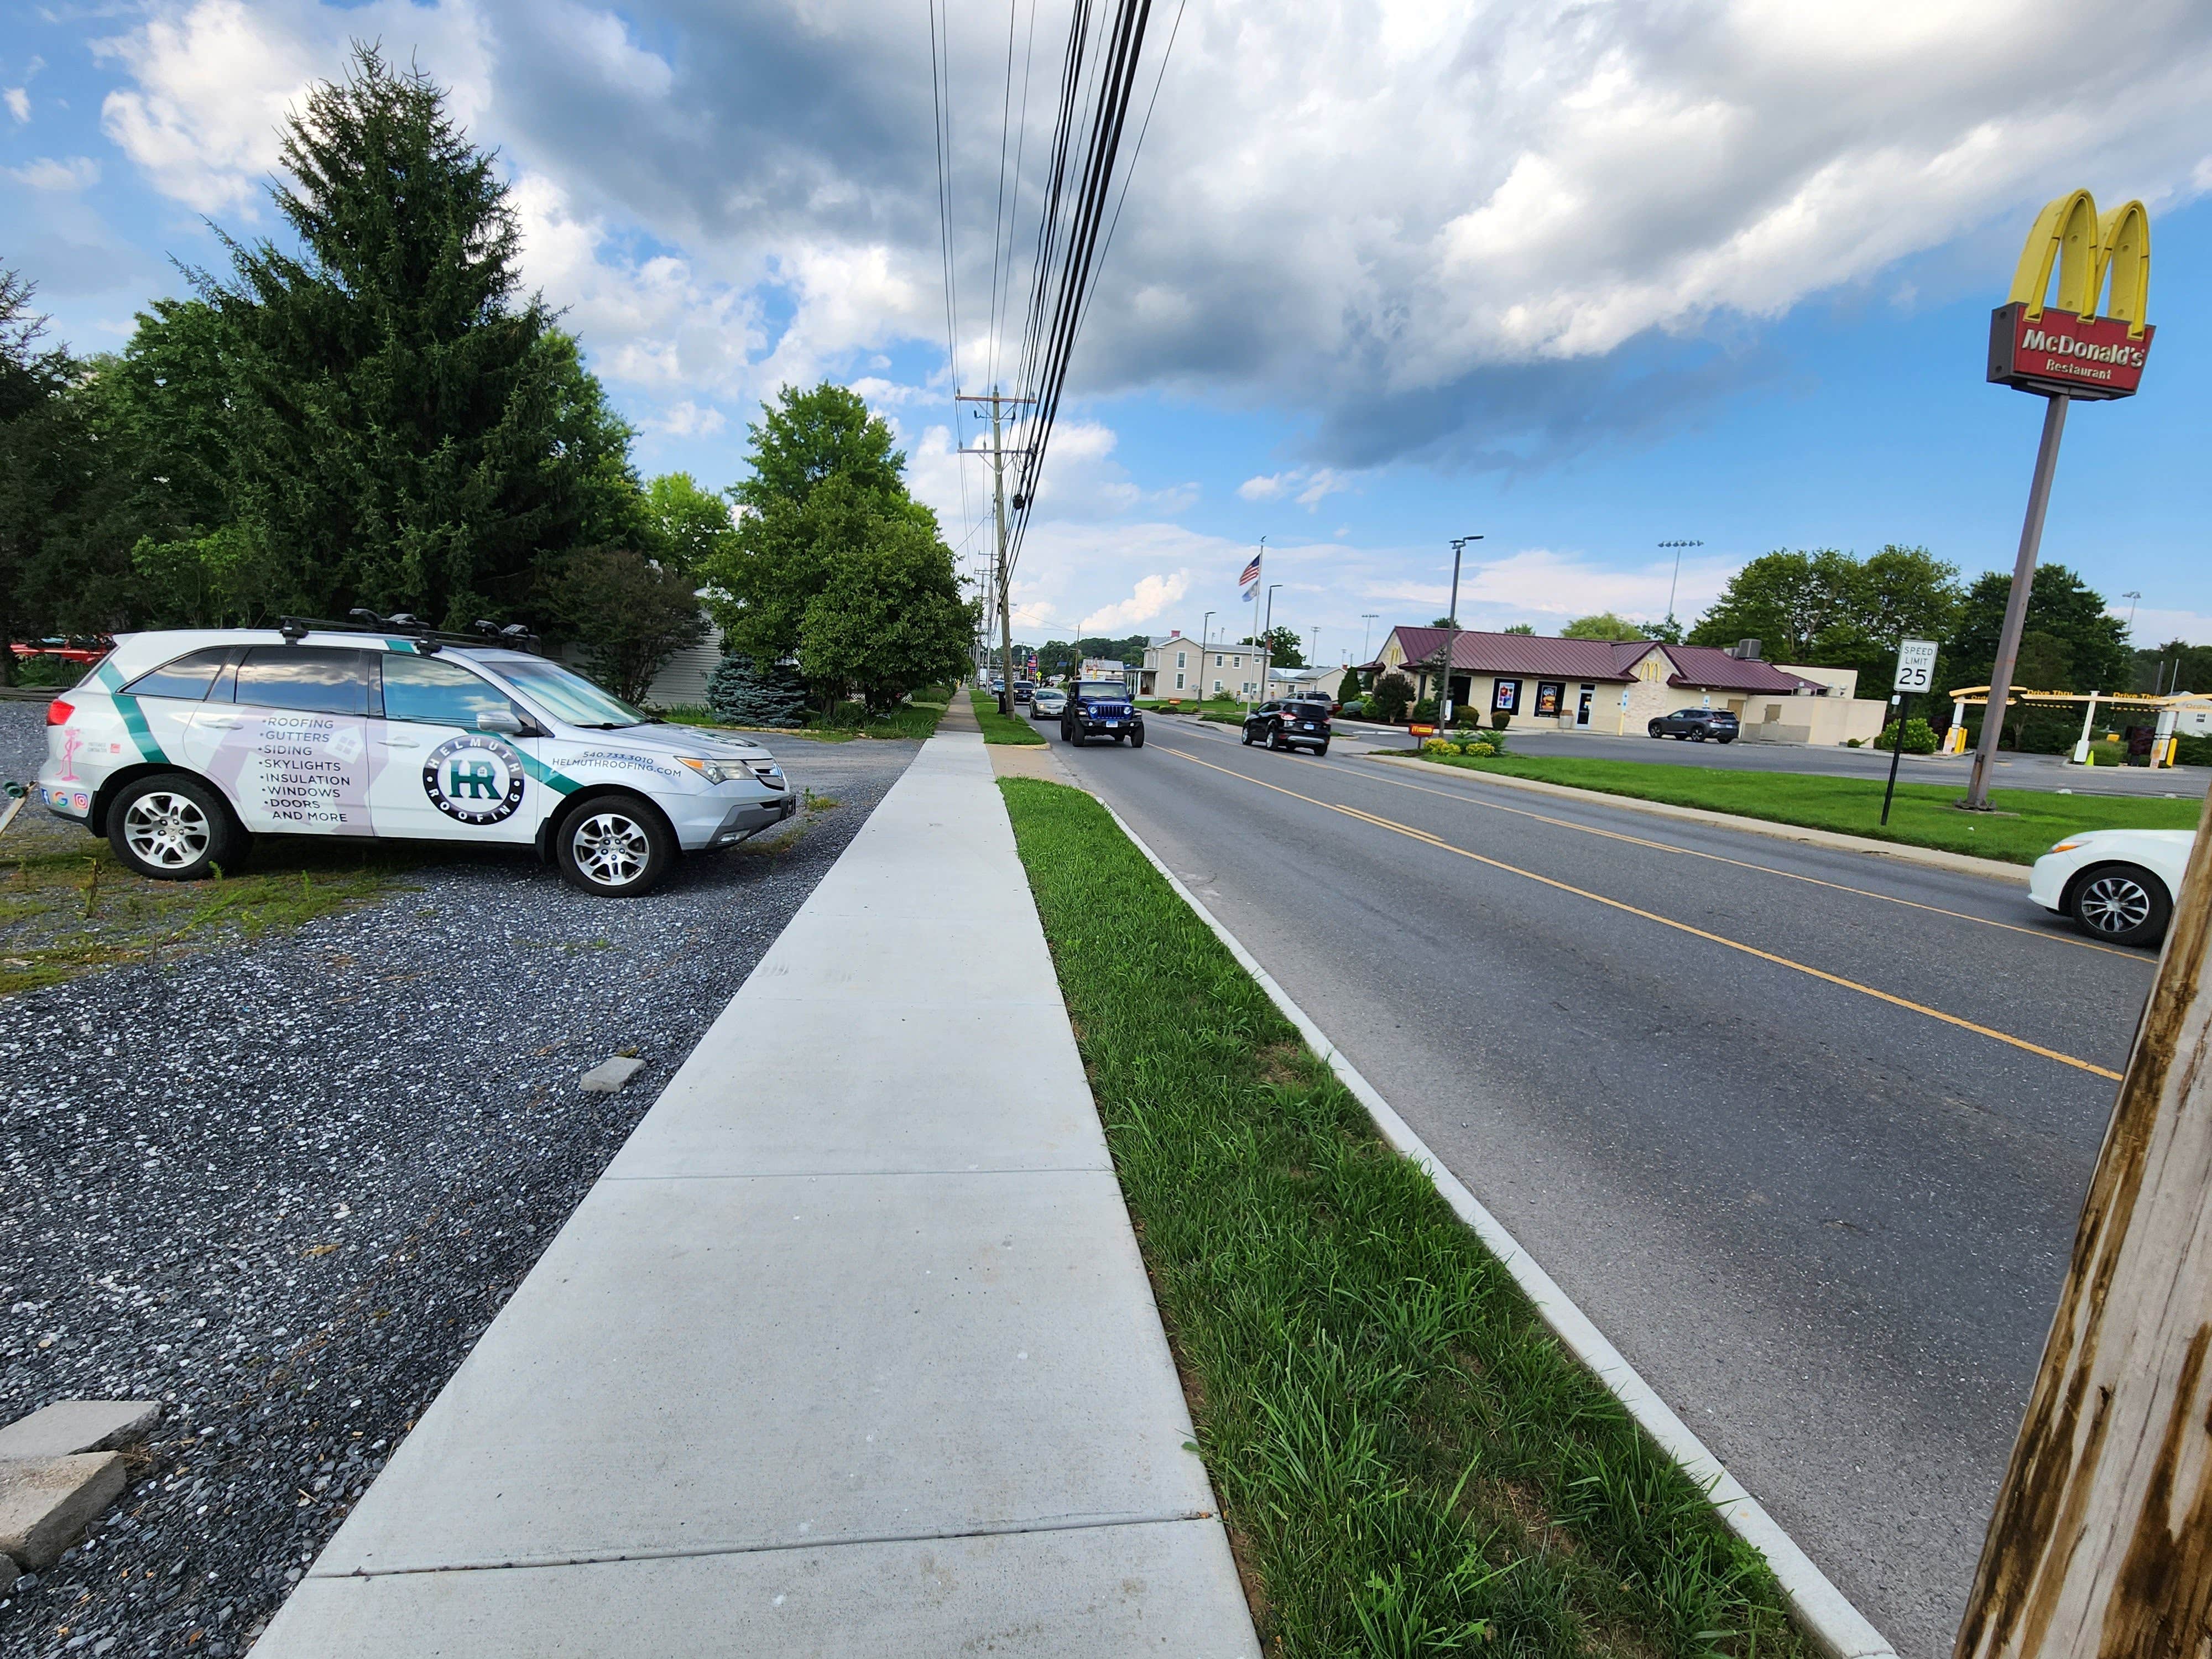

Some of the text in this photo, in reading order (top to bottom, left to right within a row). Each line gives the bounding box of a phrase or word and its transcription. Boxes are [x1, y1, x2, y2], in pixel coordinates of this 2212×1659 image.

[2022, 329, 2143, 367] McDonald's
[2046, 359, 2111, 380] Restaurant
[1904, 646, 1933, 655] SPEED
[1905, 656, 1928, 665] LIMIT
[1898, 667, 1927, 686] 25
[268, 717, 333, 729] ROOFING
[266, 731, 330, 742] GUTTERS
[264, 744, 312, 755] SIDING
[427, 738, 520, 773] HELMUTH
[583, 751, 653, 764] 540.733.3010
[265, 759, 341, 771] SKYLIGHTS
[552, 758, 681, 777] HELMUTHROOFING.COM
[266, 773, 351, 786] INSULATION
[267, 786, 341, 797] WINDOWS
[270, 799, 321, 808] DOORS
[429, 788, 520, 822] ROOFING
[272, 811, 348, 822] AND MORE
